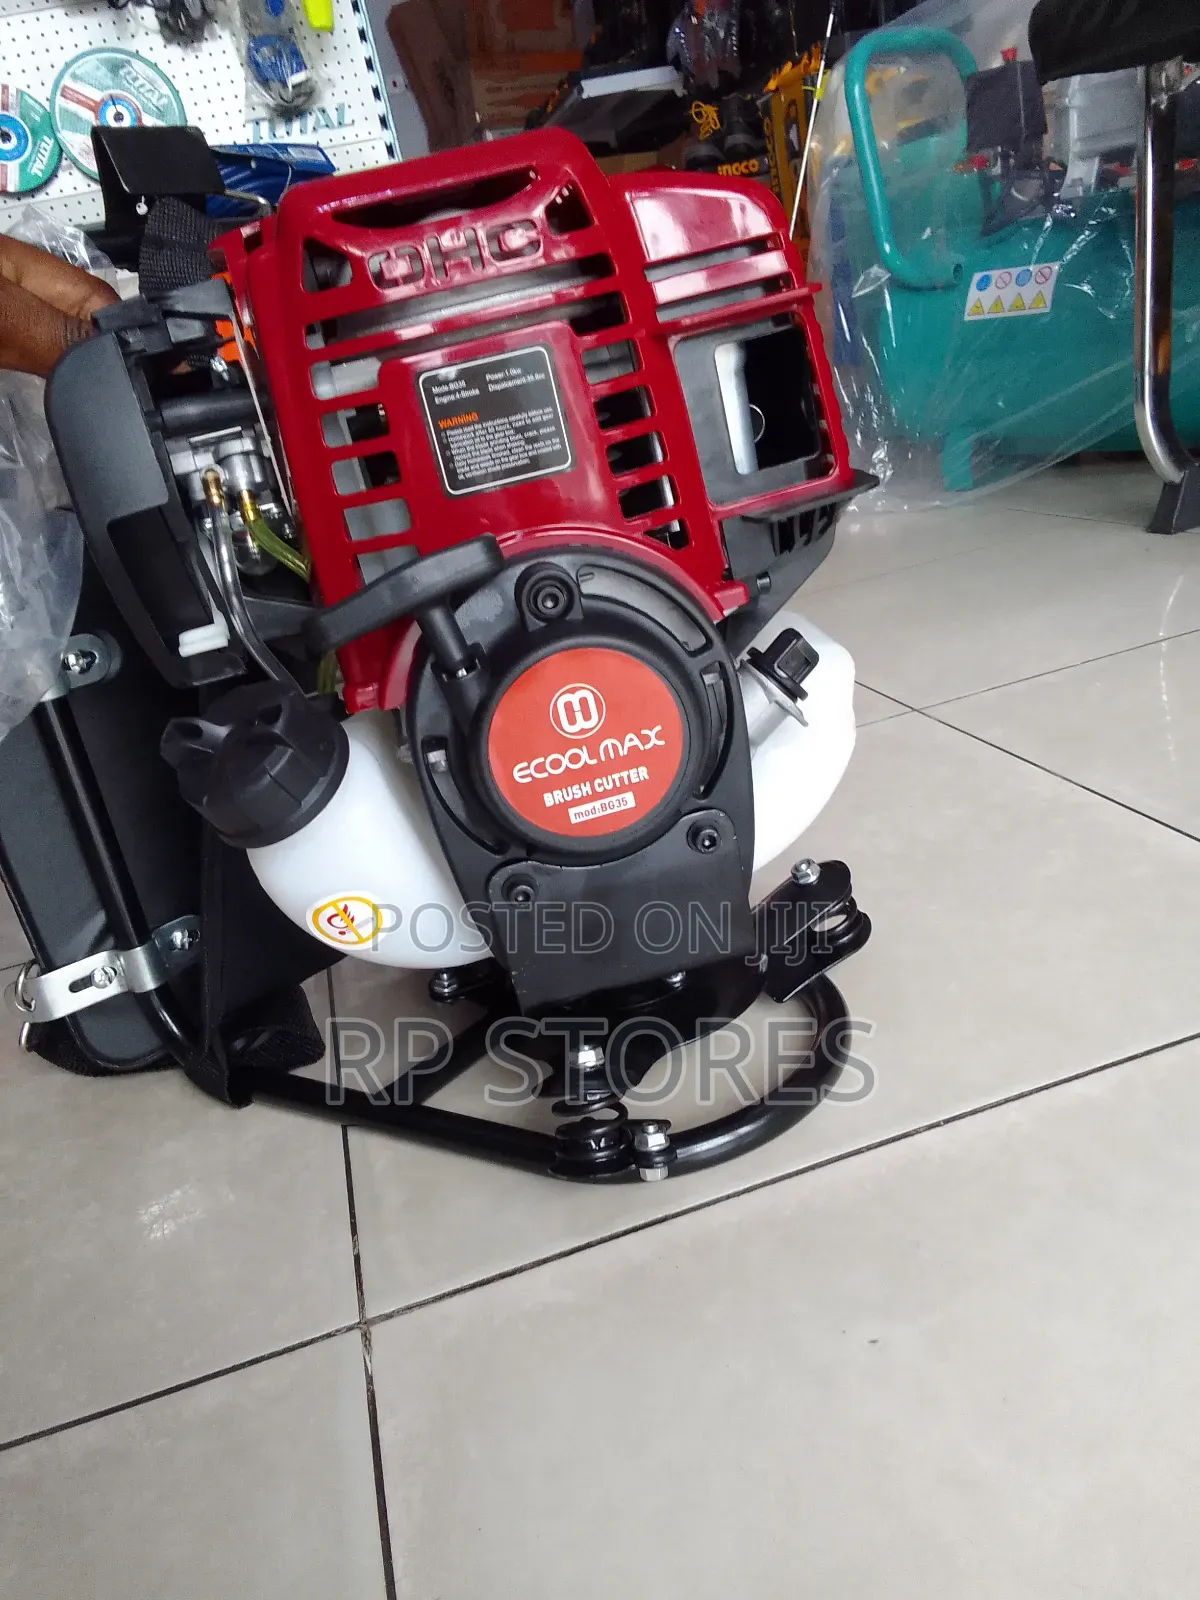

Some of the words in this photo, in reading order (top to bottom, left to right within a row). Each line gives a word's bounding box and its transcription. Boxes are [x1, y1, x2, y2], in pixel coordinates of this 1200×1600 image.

[438, 412, 479, 429] WARNING
[513, 747, 598, 784] ECOOL
[600, 725, 666, 763] MAX
[543, 782, 592, 808] BRUSH
[594, 766, 650, 796] CUTTER
[573, 797, 628, 821] mod:BG35
